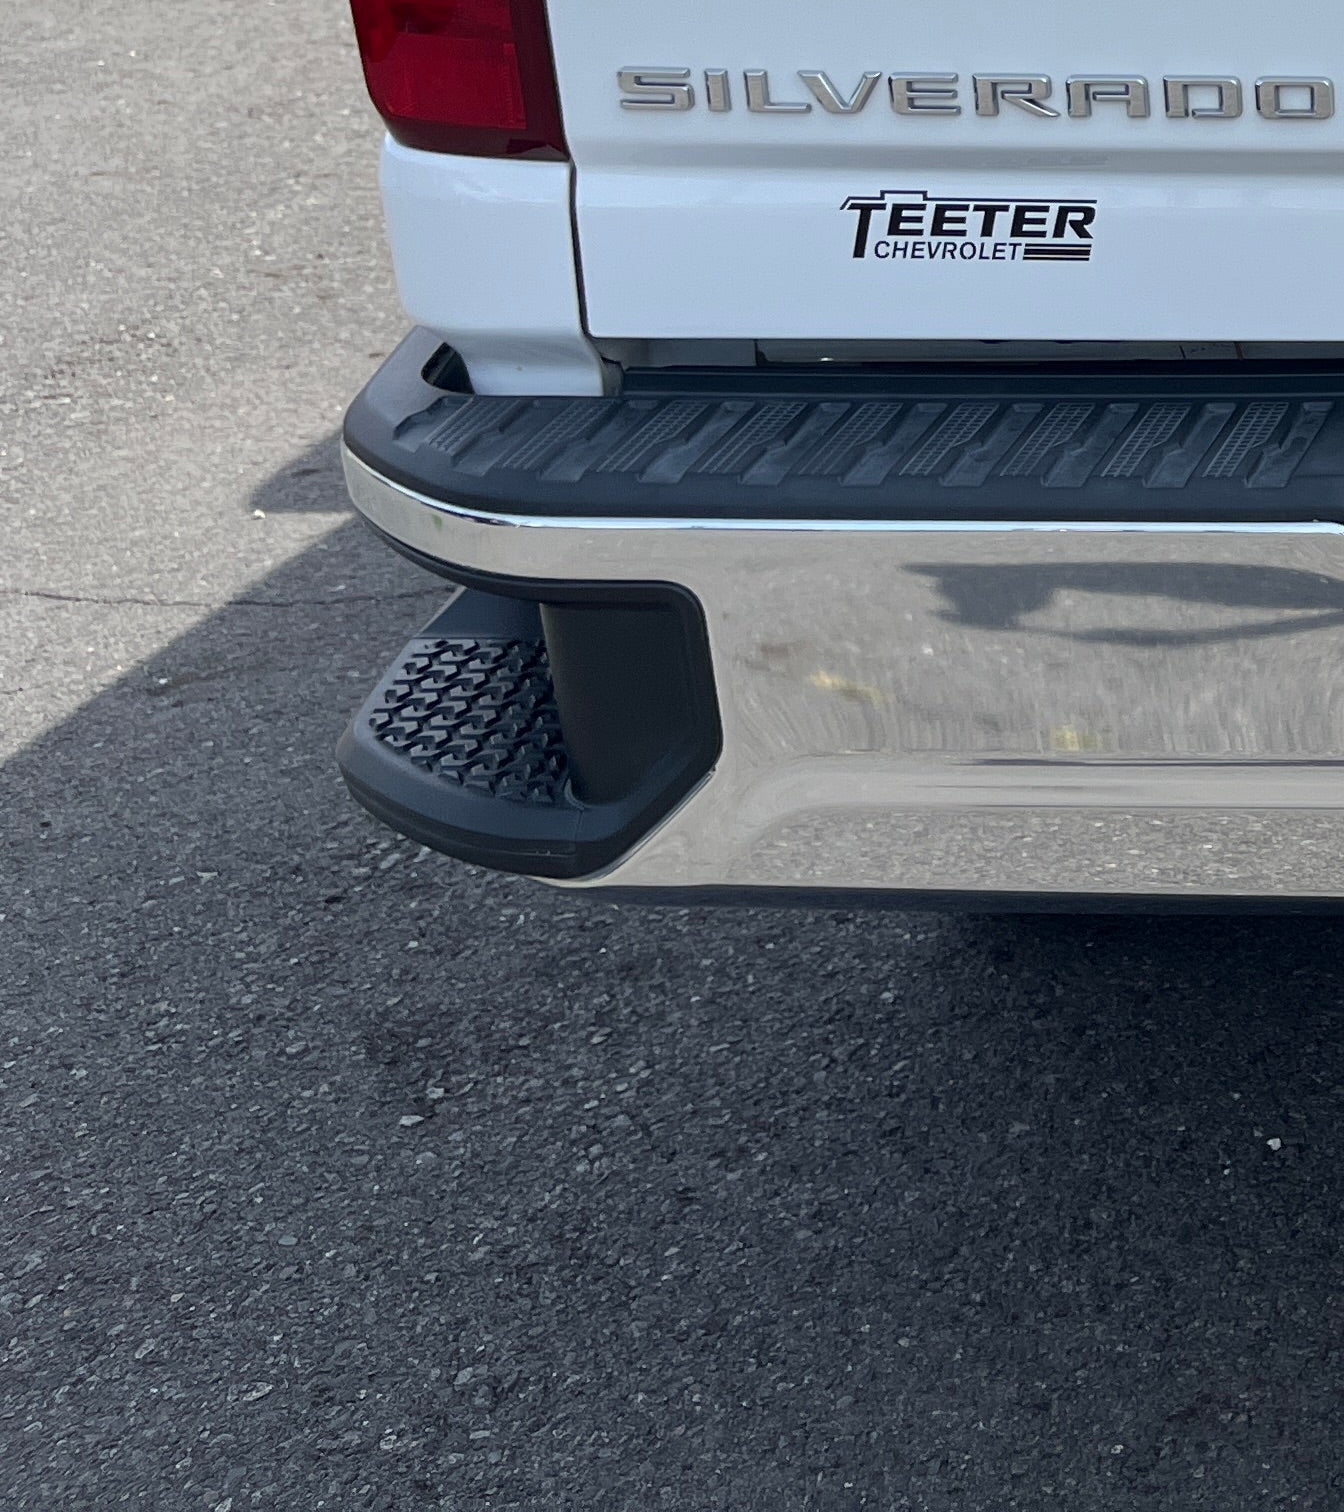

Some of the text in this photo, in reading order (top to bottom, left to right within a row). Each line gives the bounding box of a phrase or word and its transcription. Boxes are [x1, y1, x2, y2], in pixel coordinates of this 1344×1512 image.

[616, 66, 1336, 120] SILVERADO
[846, 202, 1096, 259] TEETER
[873, 240, 1022, 261] CHEVROLET
